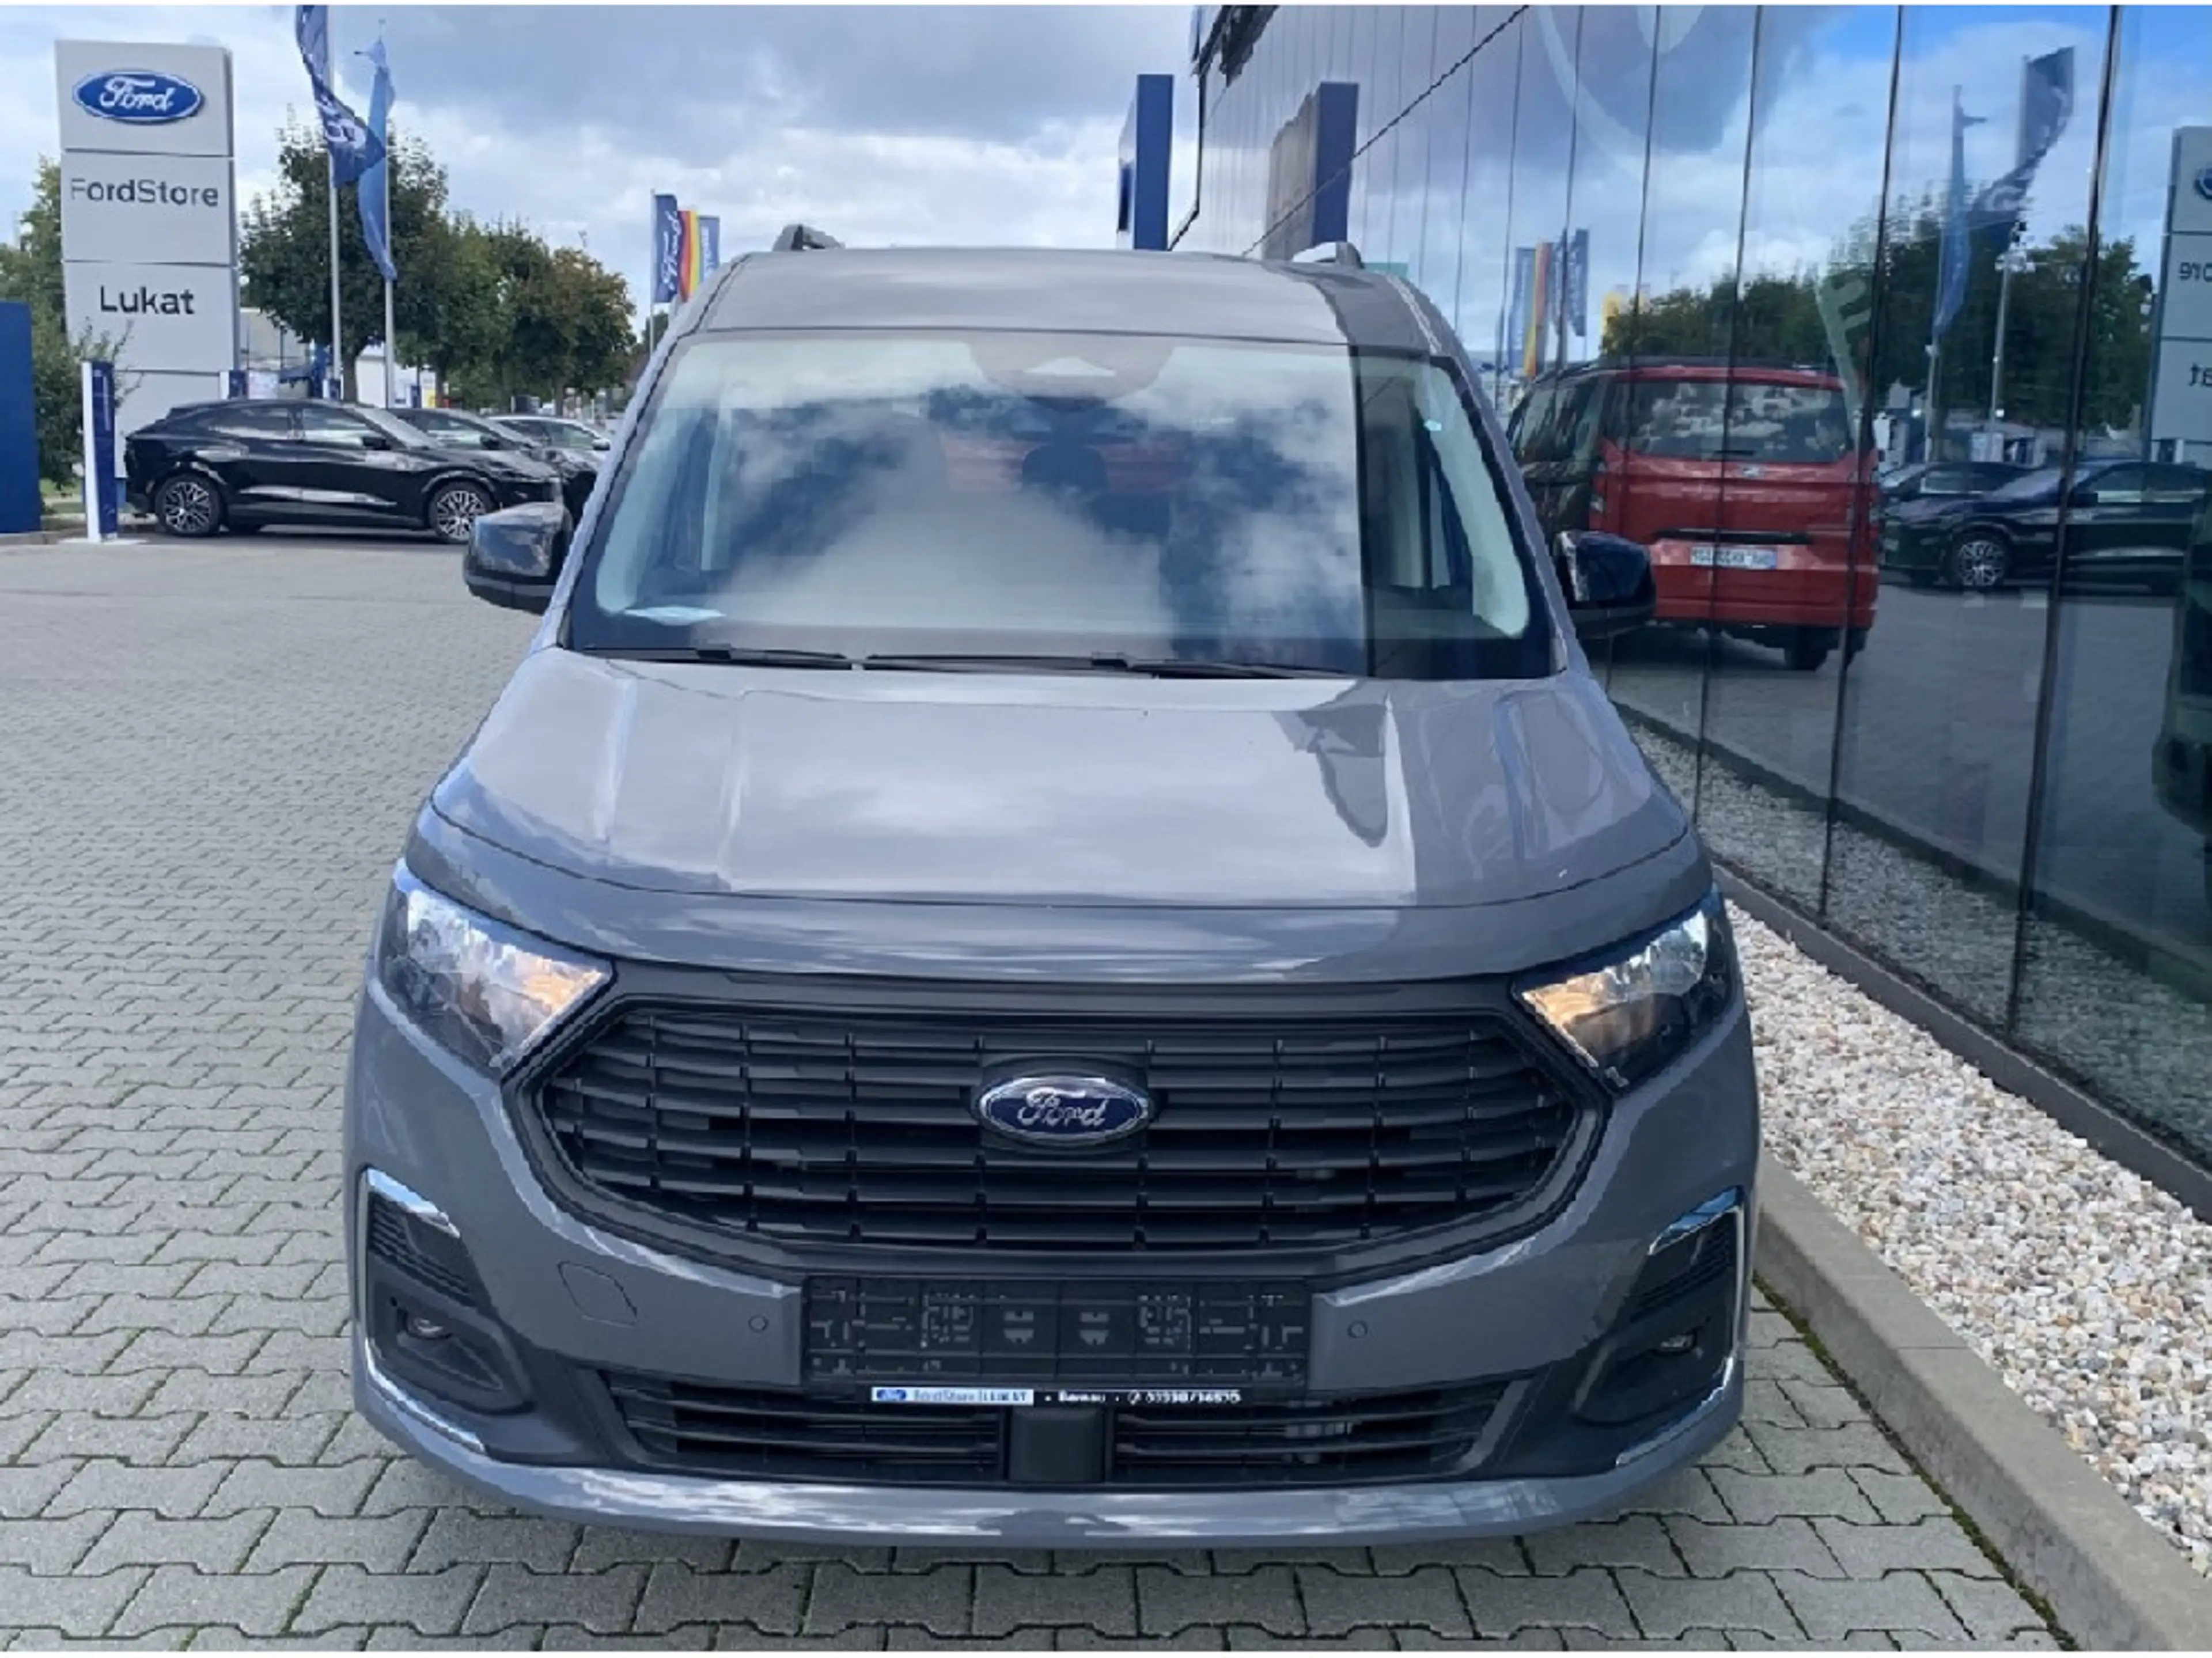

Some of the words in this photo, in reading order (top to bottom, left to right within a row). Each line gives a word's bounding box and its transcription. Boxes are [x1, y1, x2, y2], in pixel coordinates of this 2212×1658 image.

[99, 75, 176, 111] Ford
[70, 177, 219, 208] FordStore
[100, 284, 196, 315] Lukat
[1017, 1086, 1110, 1127] Ford
